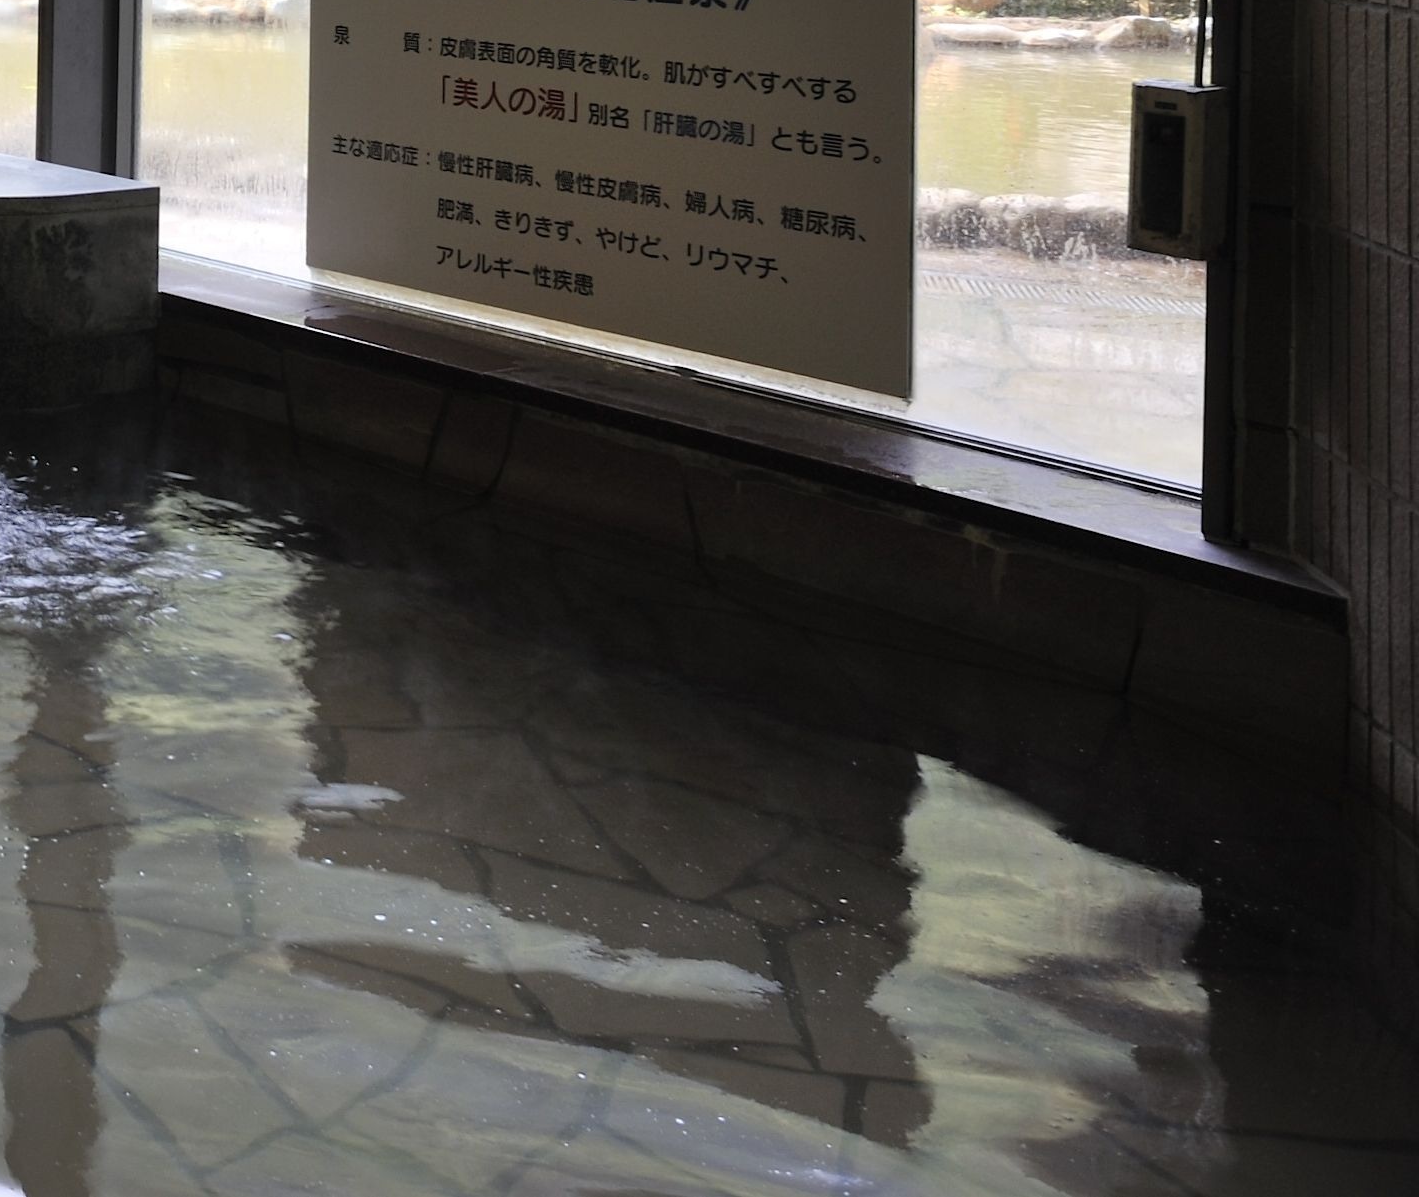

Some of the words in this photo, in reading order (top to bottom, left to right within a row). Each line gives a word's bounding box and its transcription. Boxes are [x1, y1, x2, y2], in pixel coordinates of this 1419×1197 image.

[435, 245, 595, 297] アレルギー性疾患
